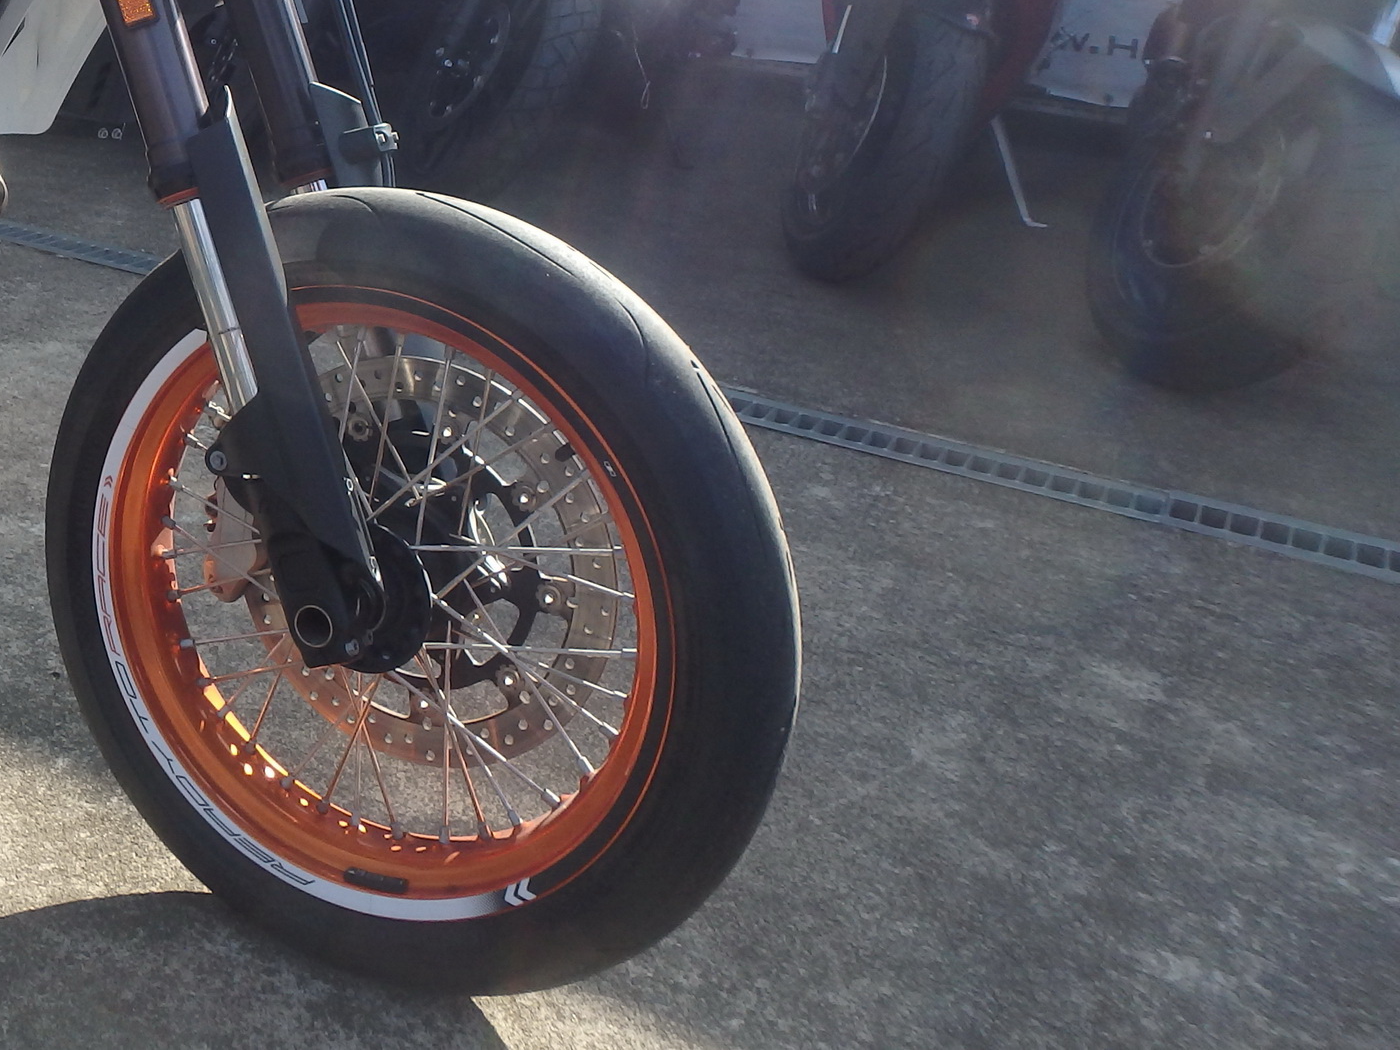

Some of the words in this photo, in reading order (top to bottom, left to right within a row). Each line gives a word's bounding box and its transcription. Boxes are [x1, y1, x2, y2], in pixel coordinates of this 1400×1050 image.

[96, 496, 122, 656] RACE
[114, 661, 149, 733] TO
[153, 740, 316, 887] READY
